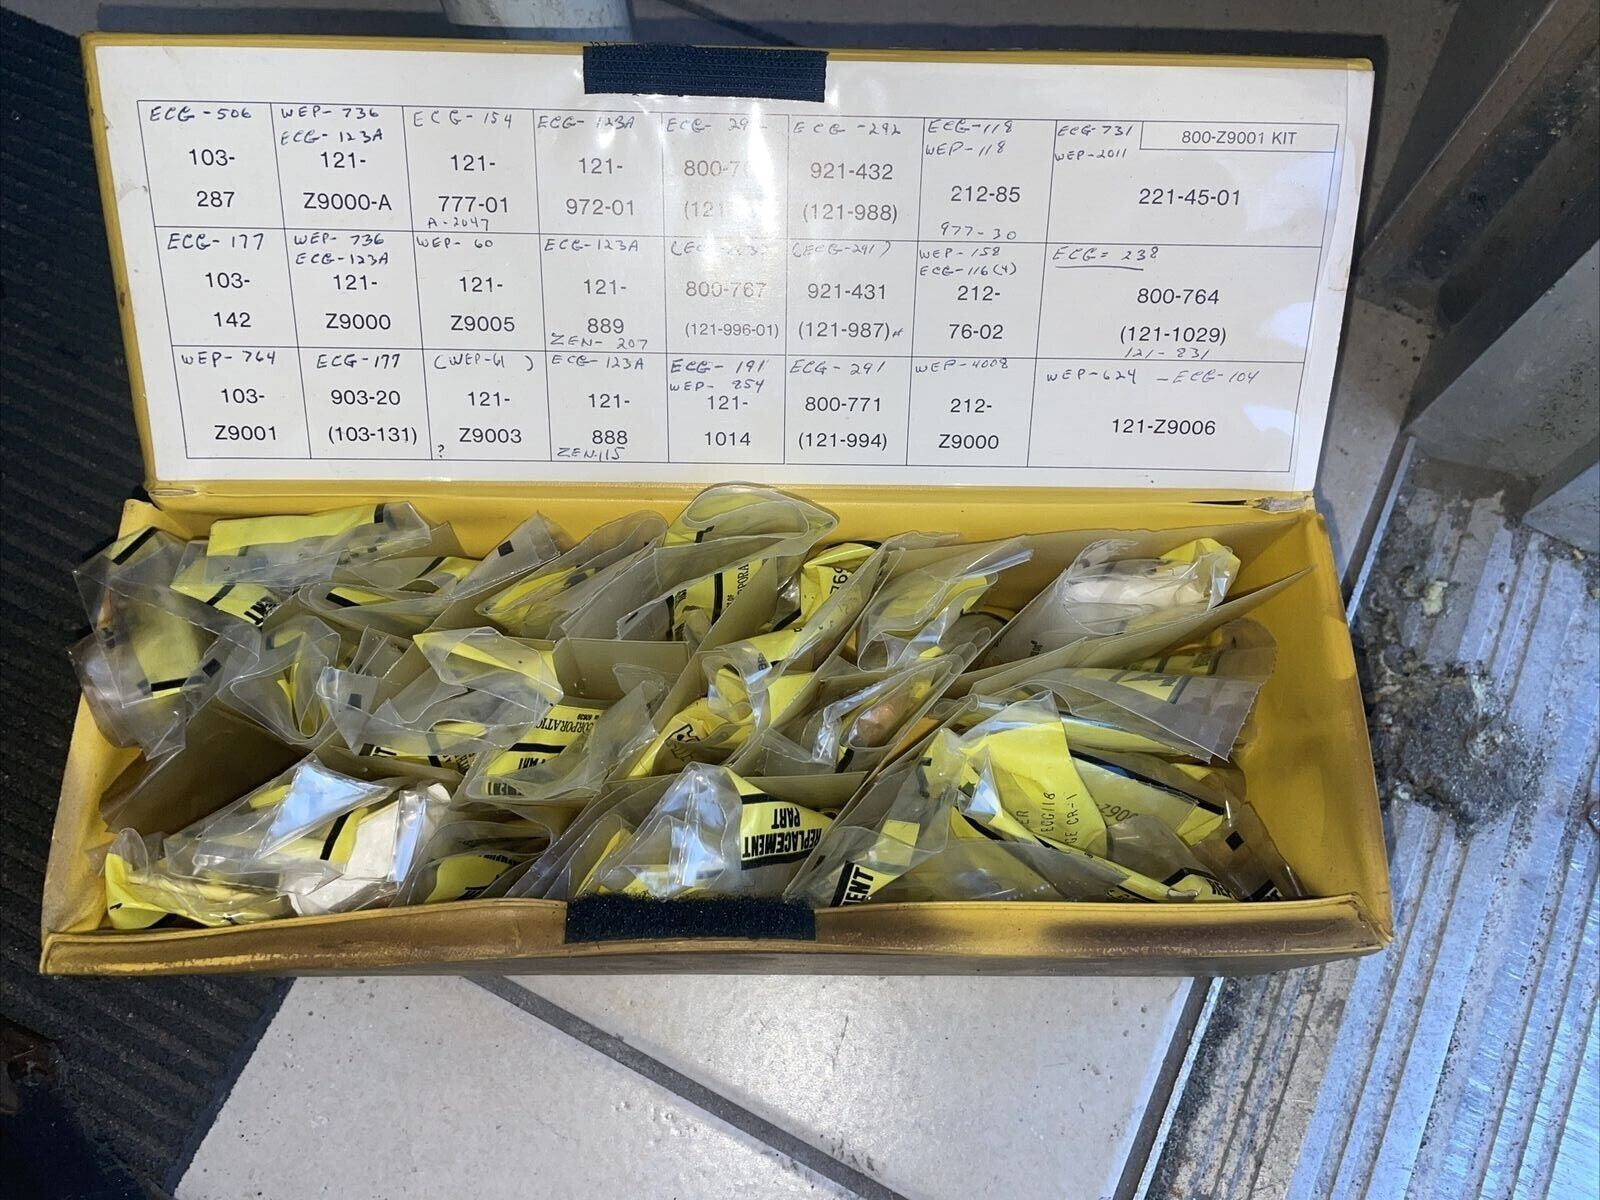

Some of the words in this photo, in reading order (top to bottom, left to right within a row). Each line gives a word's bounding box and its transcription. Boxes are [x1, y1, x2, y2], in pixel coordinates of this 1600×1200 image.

[1182, 130, 1264, 144] 800-Z9001
[1272, 132, 1297, 145] KIT
[189, 149, 236, 167] 103-
[320, 151, 367, 169] 121-
[450, 154, 496, 172] 121-
[578, 157, 624, 175] 121-
[810, 162, 894, 180] 921-432
[197, 191, 236, 208] 287
[303, 192, 393, 211] Z9000-A
[951, 185, 1021, 203] 212-85
[1138, 188, 1240, 206] 221-45-01
[438, 195, 509, 213] 777-01
[566, 198, 635, 216] 972-01
[803, 202, 898, 225] (121-988)
[205, 272, 250, 289] 103-
[333, 274, 378, 291] 121-
[459, 276, 503, 293] 121-
[583, 279, 627, 295] 121-
[685, 280, 768, 298] 800-767
[807, 283, 886, 300] 921-431
[957, 285, 1001, 301] 212-
[1137, 288, 1220, 305] 800-764
[213, 312, 252, 328] 142
[325, 313, 391, 330] Z9000
[450, 315, 516, 332] Z9005
[587, 318, 625, 334] 889
[685, 323, 780, 339] (121-996-01)
[798, 322, 891, 341] (121-987)
[948, 324, 1004, 340] 76-02
[1120, 326, 1227, 345] (121-1029)
[221, 388, 264, 403] 103-
[330, 389, 401, 405] 903-20
[467, 392, 510, 406] 121-
[588, 393, 630, 408] 121-
[707, 396, 749, 410] 121-
[805, 397, 882, 412] 800-771
[950, 398, 992, 413] 212-
[214, 425, 276, 440] Z9001
[328, 426, 418, 444] (103-131)
[459, 428, 522, 443] Z9003
[1112, 419, 1216, 436] 121-Z9006
[592, 430, 628, 445] 888
[704, 431, 751, 446] 1014
[798, 432, 888, 451] (121-994)
[938, 434, 999, 449] Z9000
[770, 807, 801, 830] PART
[742, 828, 822, 858] REPLACEMENT
